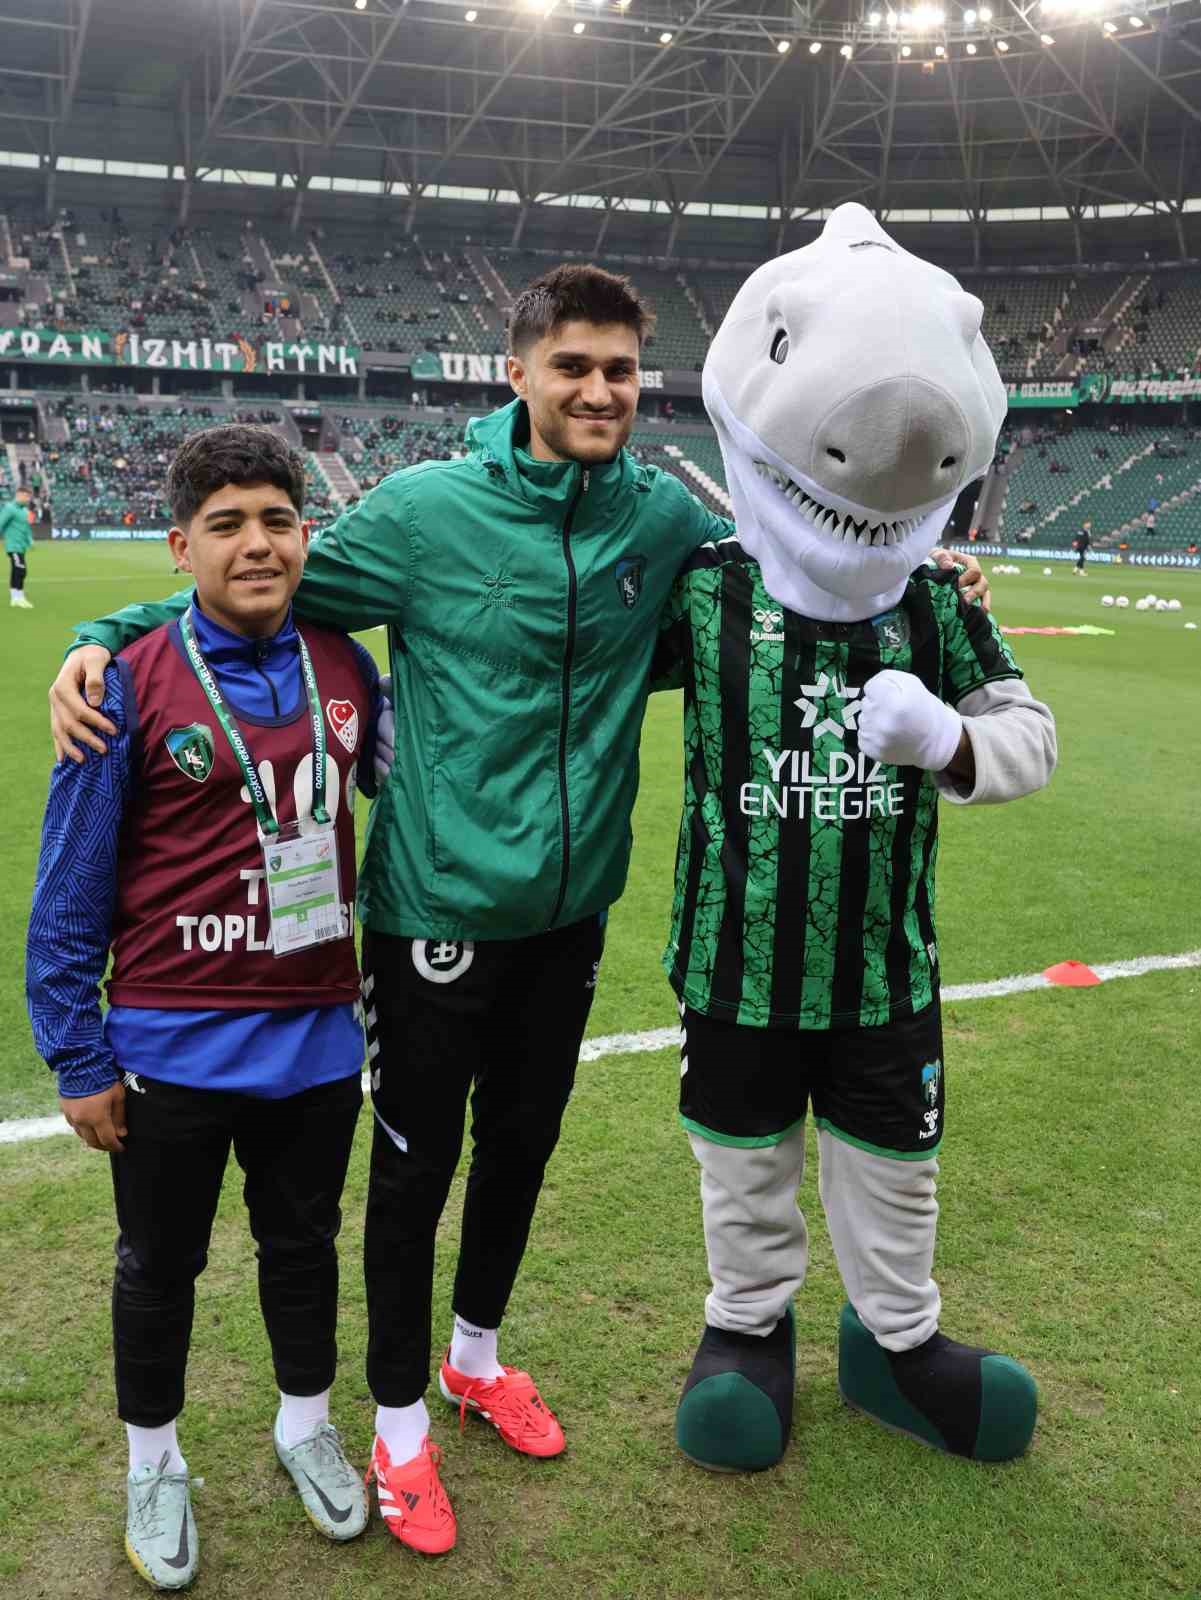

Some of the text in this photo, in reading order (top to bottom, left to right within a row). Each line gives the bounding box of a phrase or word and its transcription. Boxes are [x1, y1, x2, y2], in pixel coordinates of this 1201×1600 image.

[130, 334, 239, 369] İZMİT
[763, 748, 887, 784] YILDIZ
[739, 782, 905, 820] ENTEGRE
